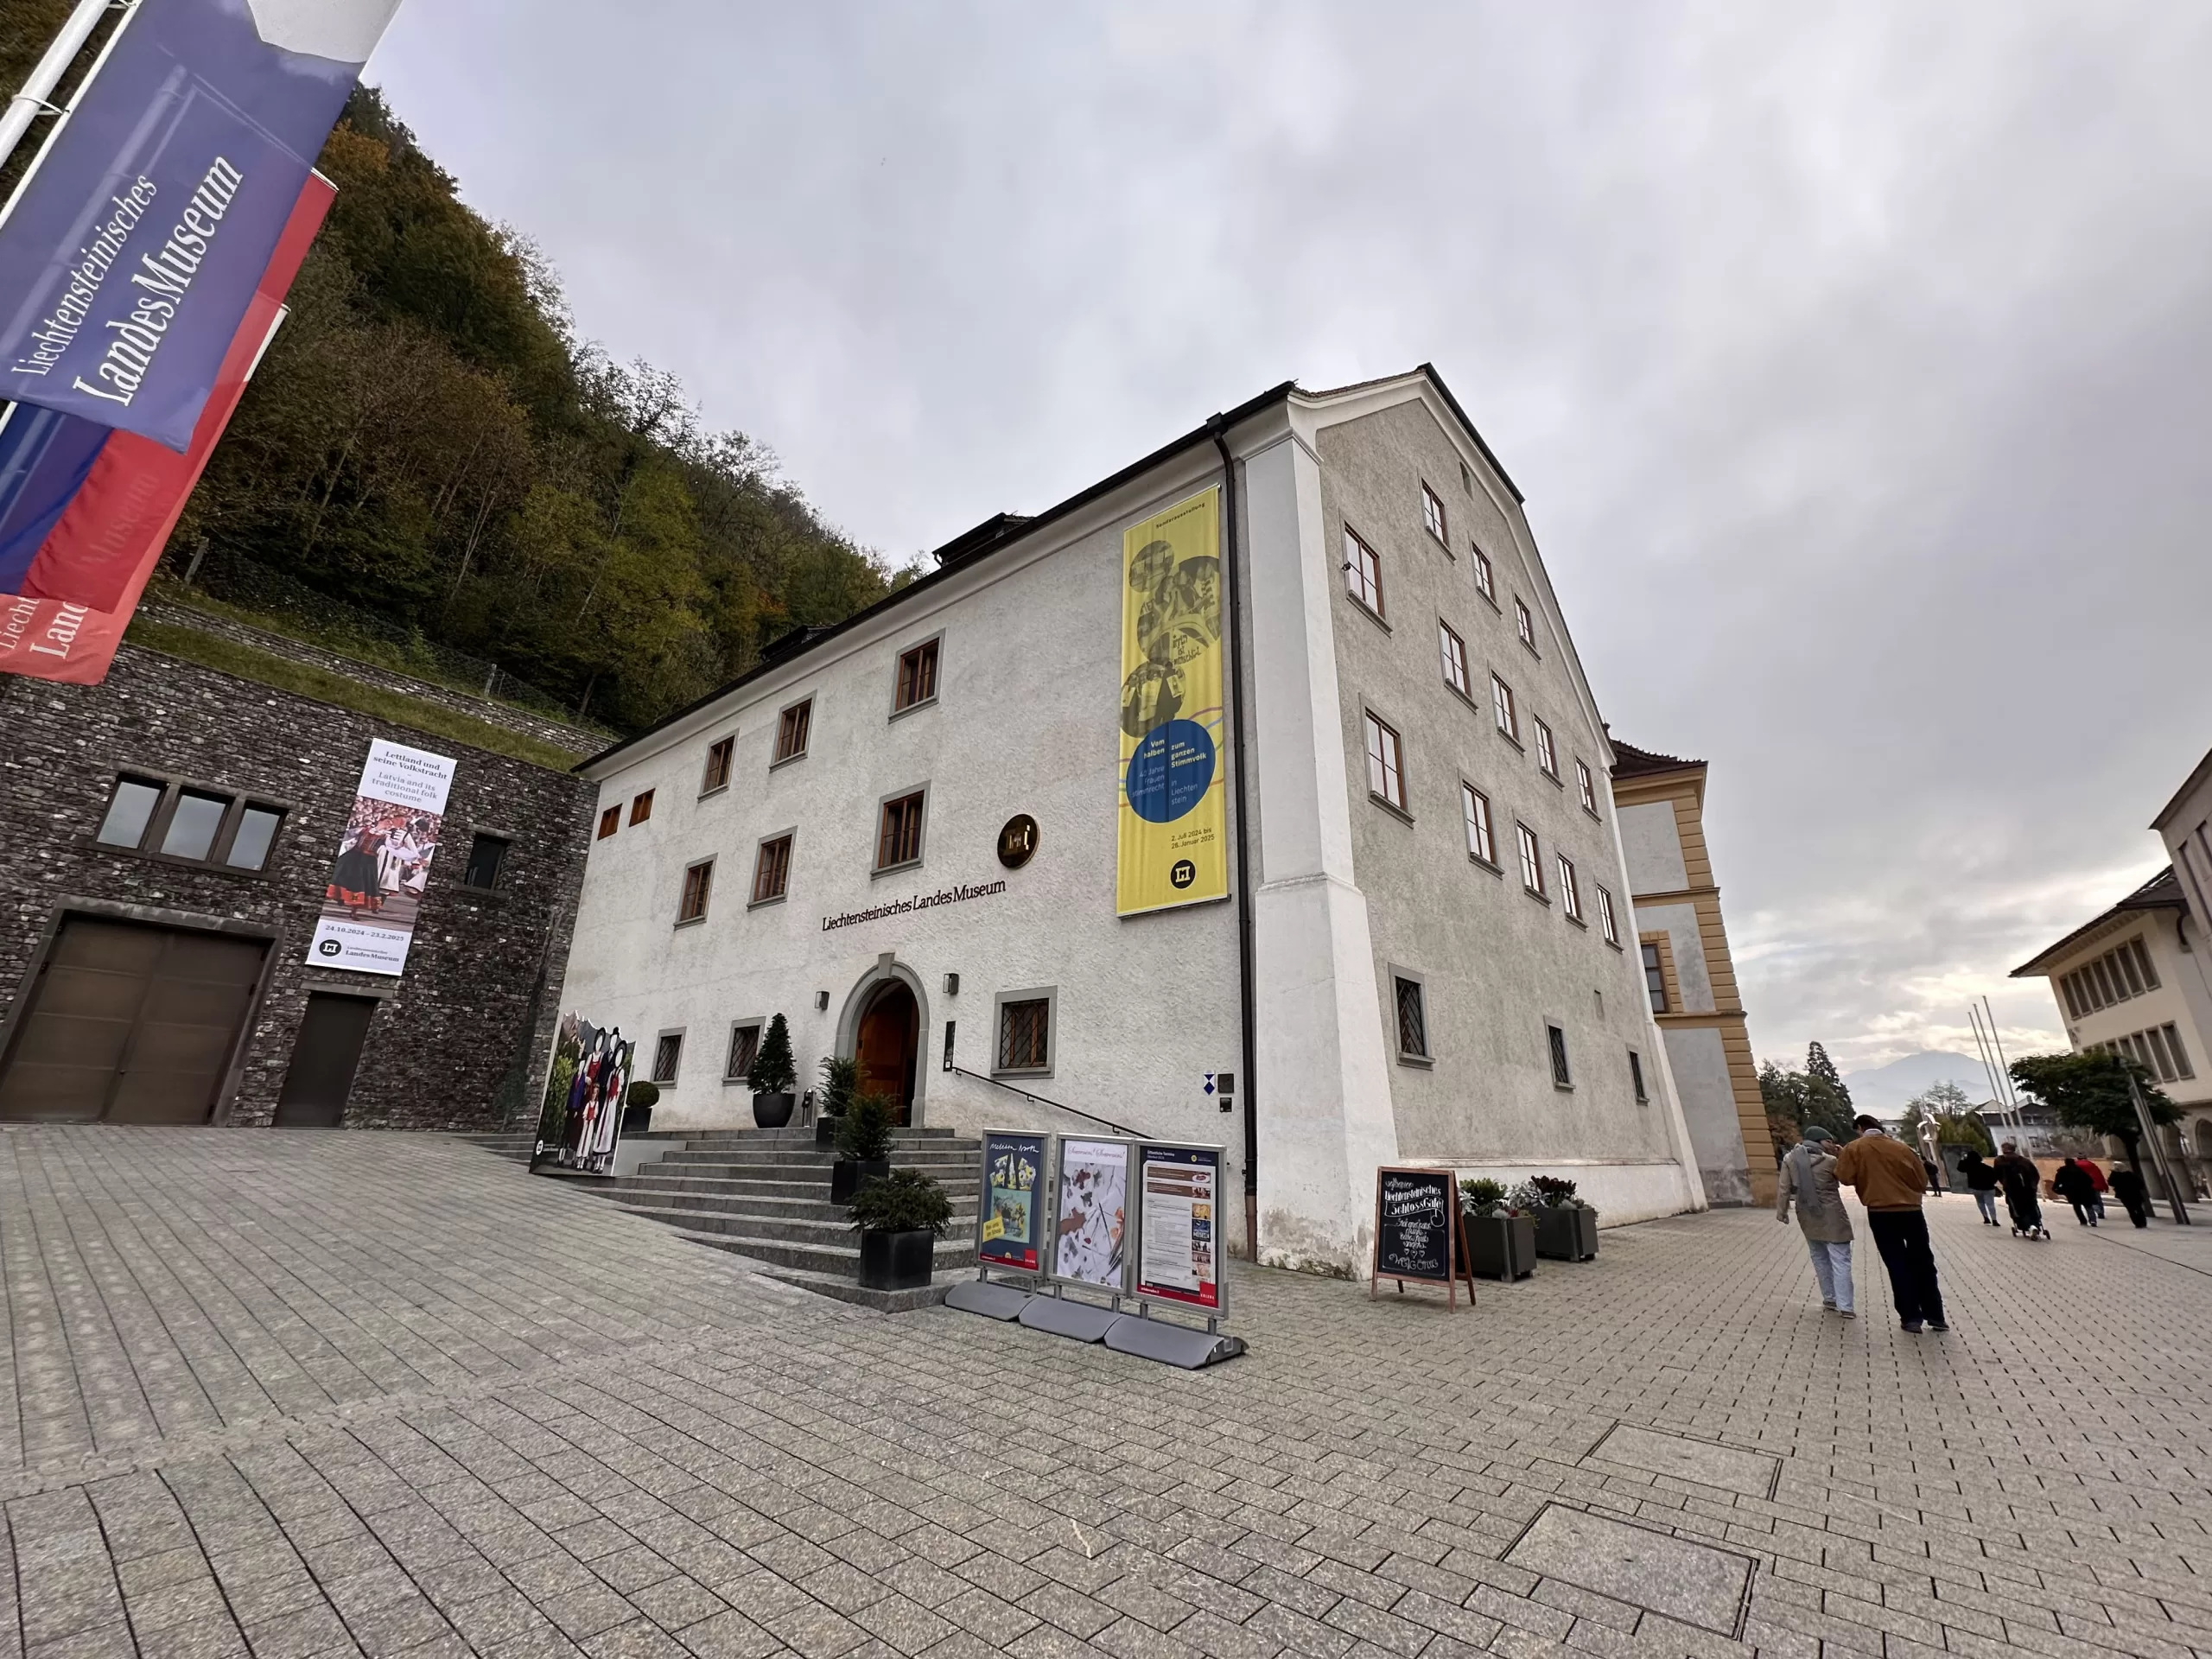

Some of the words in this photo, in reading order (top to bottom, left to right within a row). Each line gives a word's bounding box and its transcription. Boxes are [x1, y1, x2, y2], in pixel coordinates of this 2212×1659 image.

[11, 175, 156, 376] Liechtensteinisches
[1156, 502, 1205, 529] Sonderausstellung
[1150, 739, 1165, 747] Vom
[1172, 741, 1185, 751] zum
[1143, 747, 1165, 760] halben
[1171, 747, 1195, 760] ganzen
[1171, 752, 1207, 768] Stimmvolk
[373, 756, 397, 766] seine
[399, 761, 448, 779] Volkstracht
[385, 751, 422, 766] Lettland
[423, 761, 440, 771] und
[1148, 766, 1165, 776] Jahre
[378, 772, 404, 784] Latvia
[407, 779, 423, 789] and
[425, 783, 435, 791] its
[1144, 774, 1165, 785] Frauen
[372, 778, 419, 794] traditional
[421, 790, 437, 799] folk
[1171, 783, 1198, 796] Liechten
[385, 790, 422, 803] costume
[1171, 795, 1187, 805] stein
[1178, 832, 1187, 841] Juli
[1188, 829, 1202, 838] 2024
[1181, 838, 1199, 848] Januar
[1200, 834, 1215, 843] 2025
[822, 899, 912, 931] Liechtensteinisches
[325, 925, 365, 936] 24.10.2024
